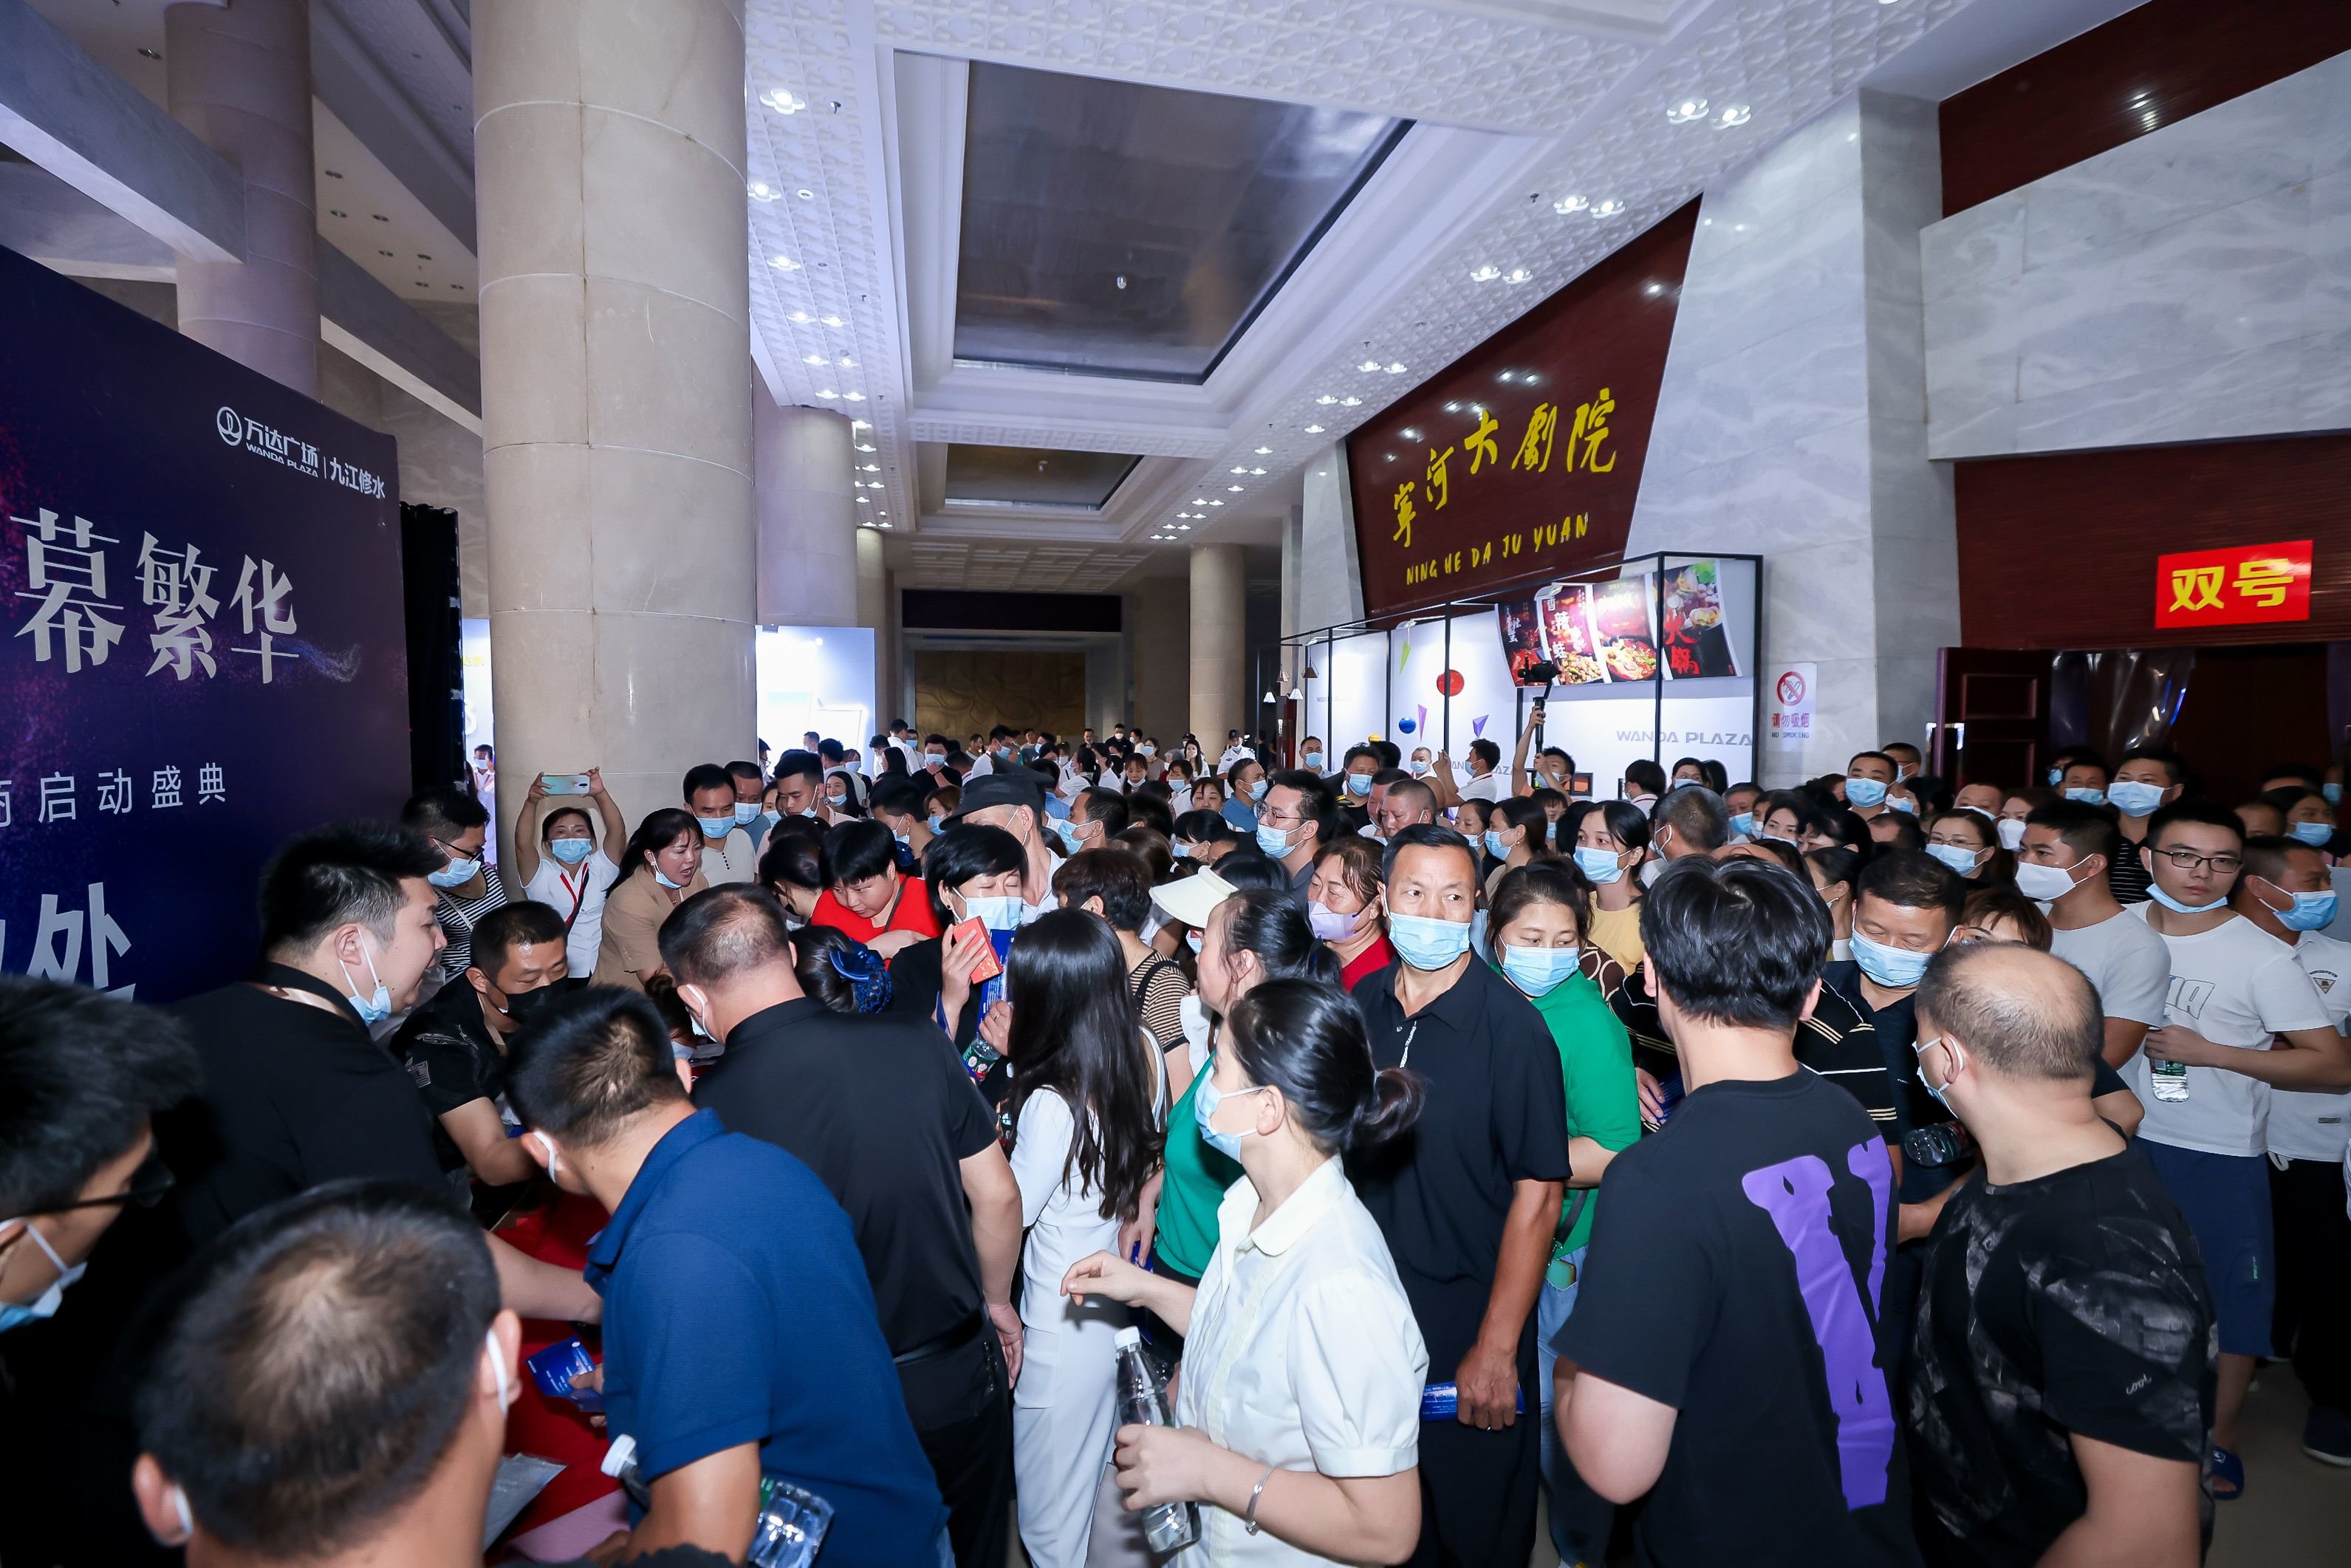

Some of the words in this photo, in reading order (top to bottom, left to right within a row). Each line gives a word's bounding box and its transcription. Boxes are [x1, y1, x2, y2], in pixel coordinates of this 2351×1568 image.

[244, 417, 318, 468] 万达广场
[330, 456, 386, 499] 九江修水
[246, 442, 284, 465] WANDA
[287, 459, 318, 478] PLAZA
[1406, 560, 1437, 585] NING
[1444, 551, 1461, 574] HE
[1471, 541, 1492, 567] DA
[1502, 533, 1522, 558] JU
[1533, 512, 1589, 552] YUAN
[10, 507, 299, 685] 幕繁华
[2169, 558, 2294, 613] 双号
[1686, 732, 1753, 746] PLAZA
[1772, 712, 1810, 728] 请勿吸烟
[0, 882, 136, 1003] 处
